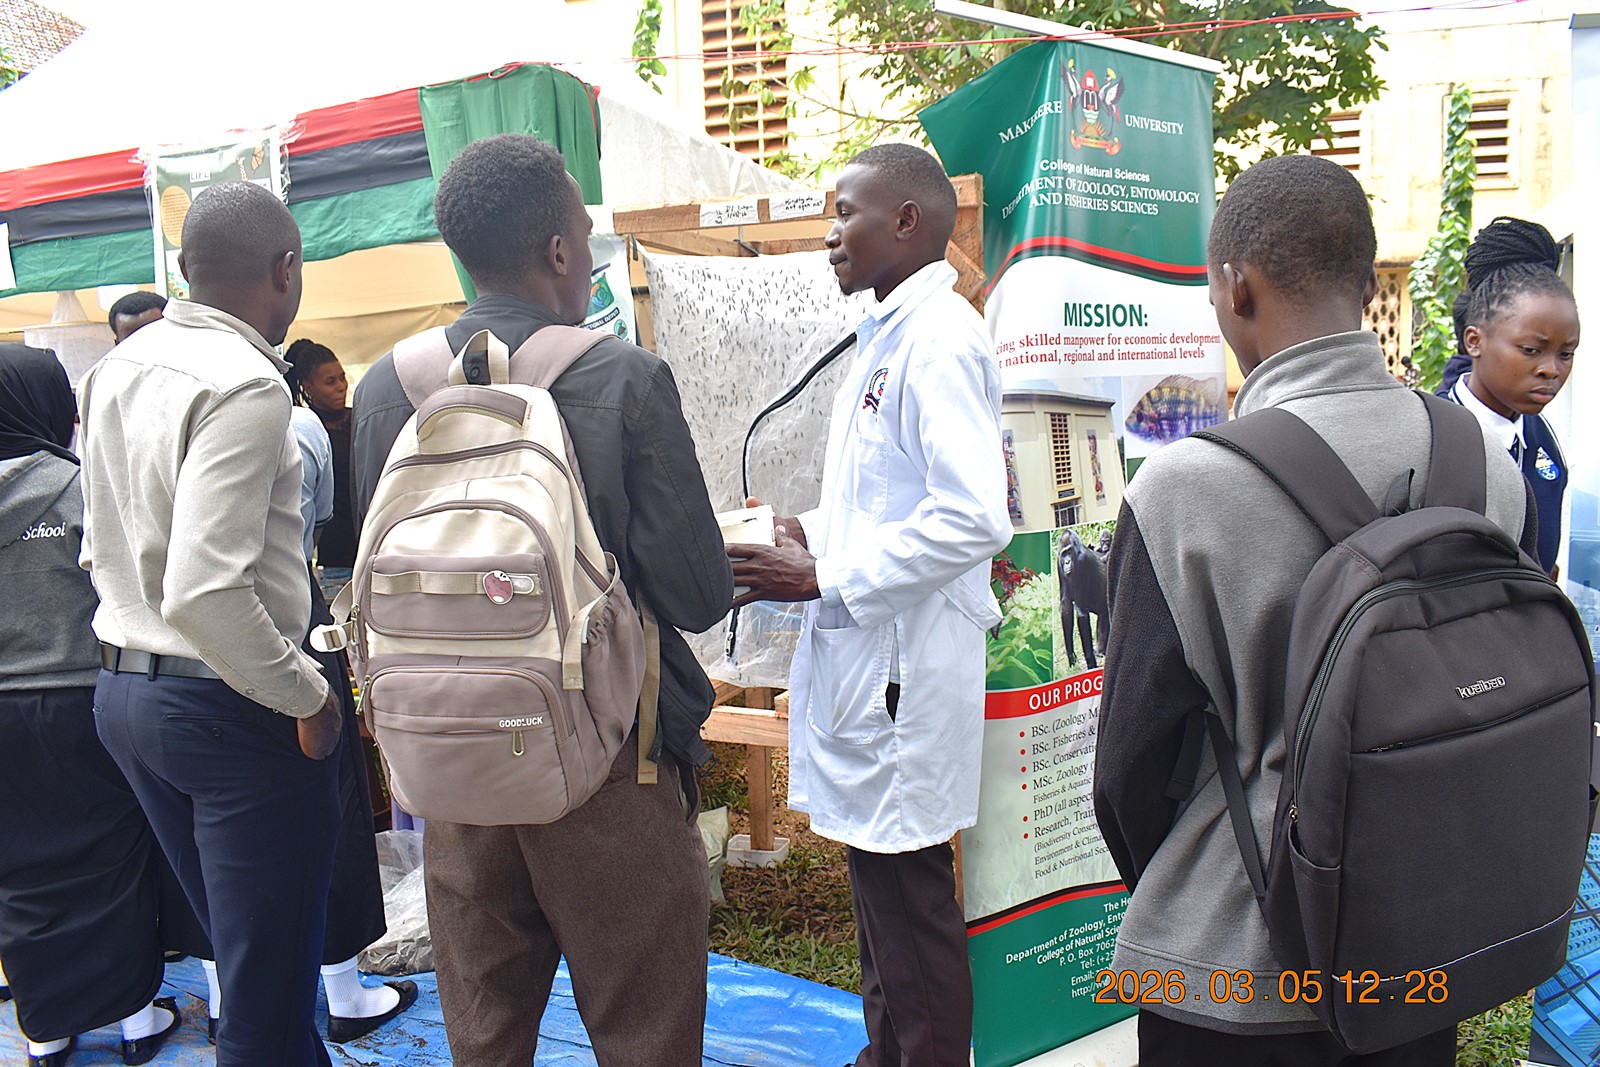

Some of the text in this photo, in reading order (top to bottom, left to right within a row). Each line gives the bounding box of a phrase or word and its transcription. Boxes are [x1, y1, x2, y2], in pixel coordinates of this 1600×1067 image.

[998, 100, 1184, 144] MAKERERE UNIVERSITY
[1040, 159, 1150, 183] College of Natural Sciences
[1065, 178, 1077, 189] OF
[1077, 180, 1129, 199] ZOOLOGY,
[1130, 186, 1200, 204] ENTOMOLOGY
[1029, 193, 1159, 216] AND FISHERIES SCIENCES
[1064, 302, 1148, 328] MISSION:
[1019, 333, 1062, 348] skilled
[1063, 335, 1105, 348] manpower
[1107, 333, 1121, 345] for
[1124, 333, 1168, 345] economic
[1169, 332, 1221, 346] development
[1005, 349, 1062, 367] national,
[1063, 349, 1095, 364] regional
[1097, 349, 1115, 361] and
[1117, 347, 1178, 361] international
[1179, 347, 1205, 359] levels
[1029, 688, 1061, 710] OUR
[1031, 724, 1050, 738] BSc.
[1052, 713, 1087, 734] (Zoology
[1032, 725, 1096, 756] BSc. Fisheries &
[1032, 759, 1051, 773] BSc.
[1033, 776, 1054, 790] MSc.
[1056, 762, 1088, 783] Zoology
[1033, 776, 1092, 804] Fisheries & Aquatic
[1034, 805, 1053, 822] PhD
[1054, 799, 1067, 814] (all
[1034, 817, 1072, 838] Research,
[1034, 832, 1071, 853] (Biodiversity
[1034, 844, 1073, 865] Environment
[1074, 840, 1080, 849] &
[1035, 865, 1052, 879] Food
[1052, 862, 1058, 872] &
[1059, 849, 1094, 868] Nutritional
[1103, 901, 1119, 913] The
[1006, 936, 1057, 964] Department
[1059, 932, 1068, 943] of
[1069, 920, 1106, 938] Zoology,
[1037, 945, 1065, 965] College
[1065, 940, 1074, 951] of
[1074, 930, 1104, 948] Natural
[1059, 956, 1067, 967] P.
[1068, 952, 1077, 963] O.
[1078, 947, 1094, 959] Box
[1080, 957, 1095, 970] Tel:
[1071, 970, 1095, 987] Email:
